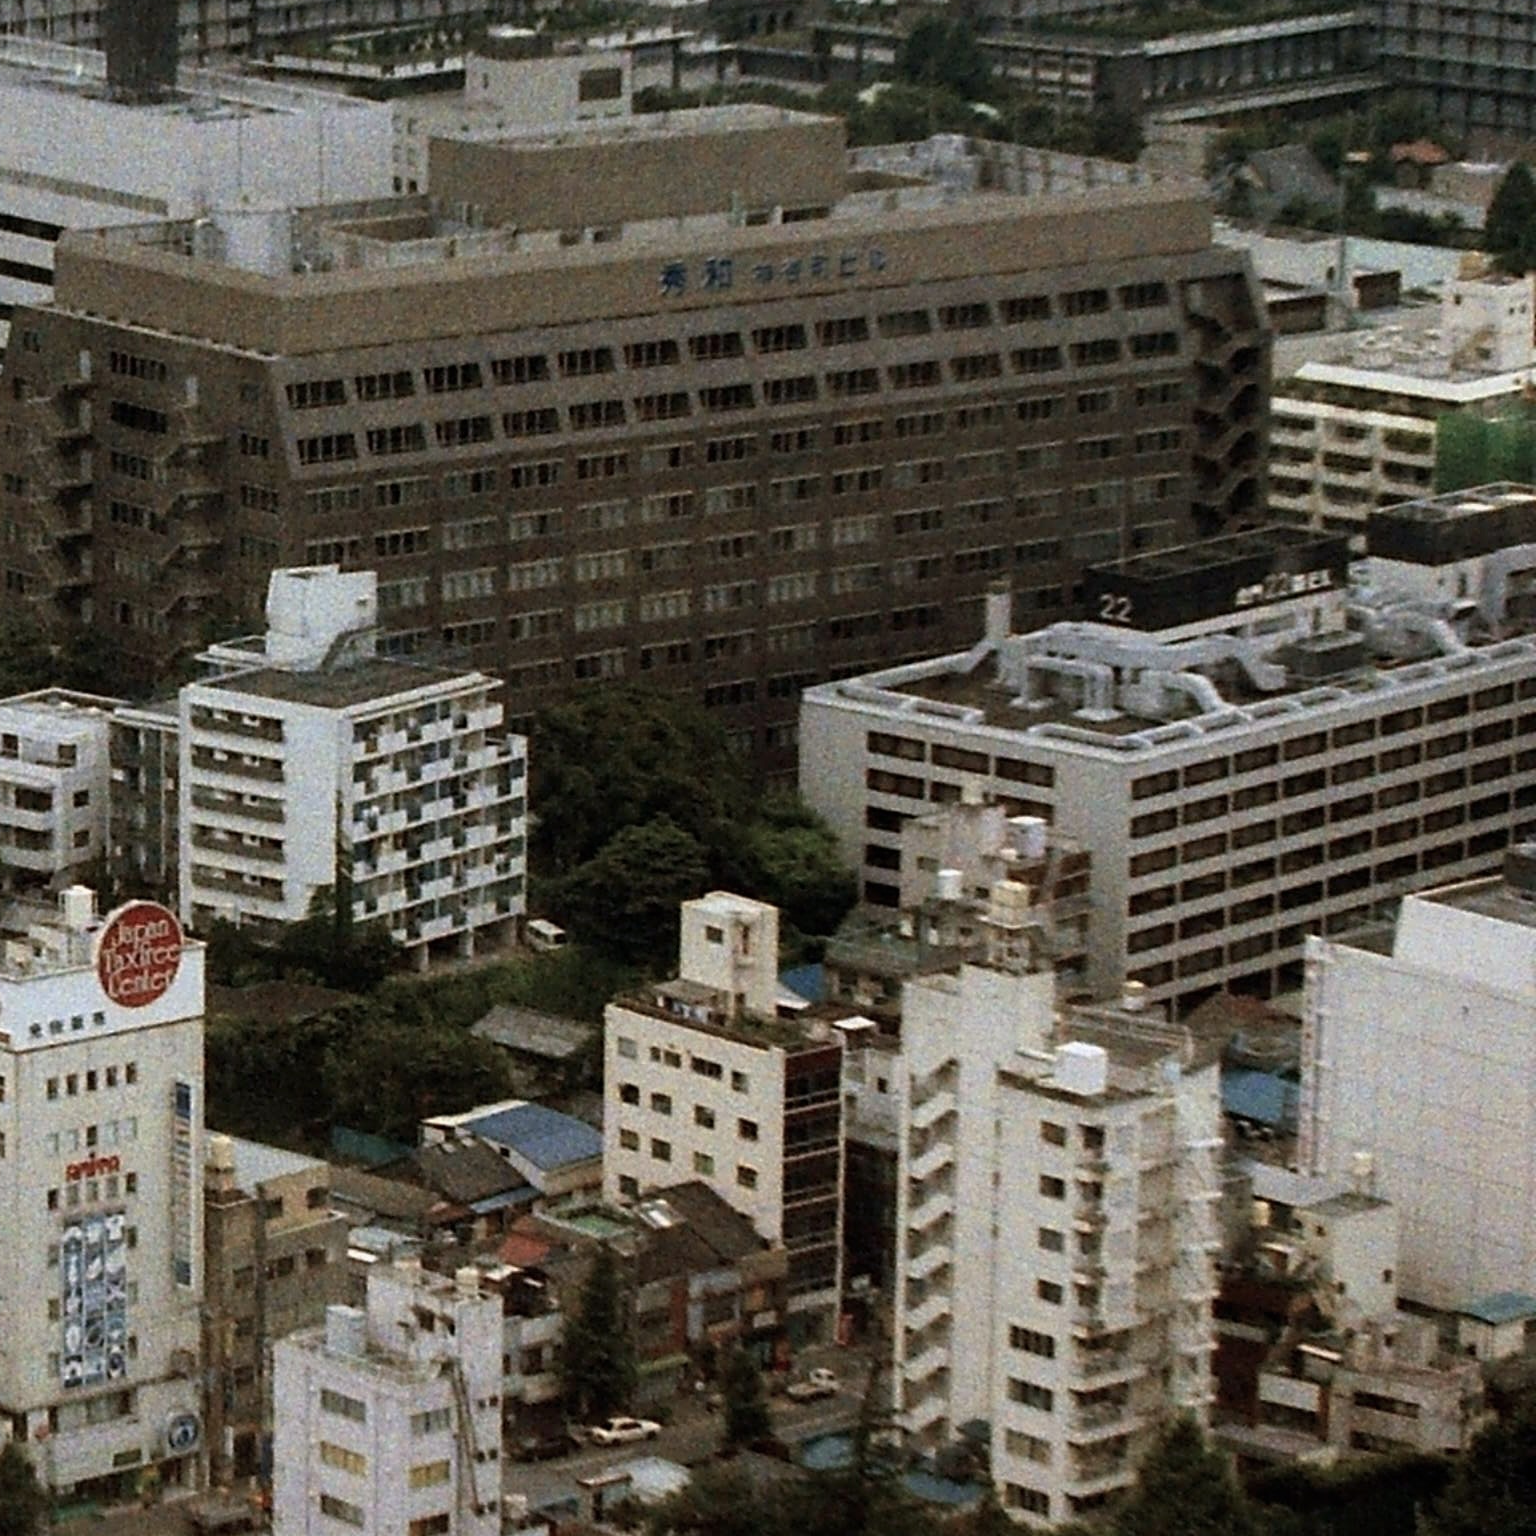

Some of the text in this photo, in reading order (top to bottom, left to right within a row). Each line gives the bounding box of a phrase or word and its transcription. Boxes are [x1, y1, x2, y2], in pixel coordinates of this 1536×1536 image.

[1099, 595, 1133, 623] 22
[113, 920, 169, 952] Japan
[109, 968, 173, 999] Center
